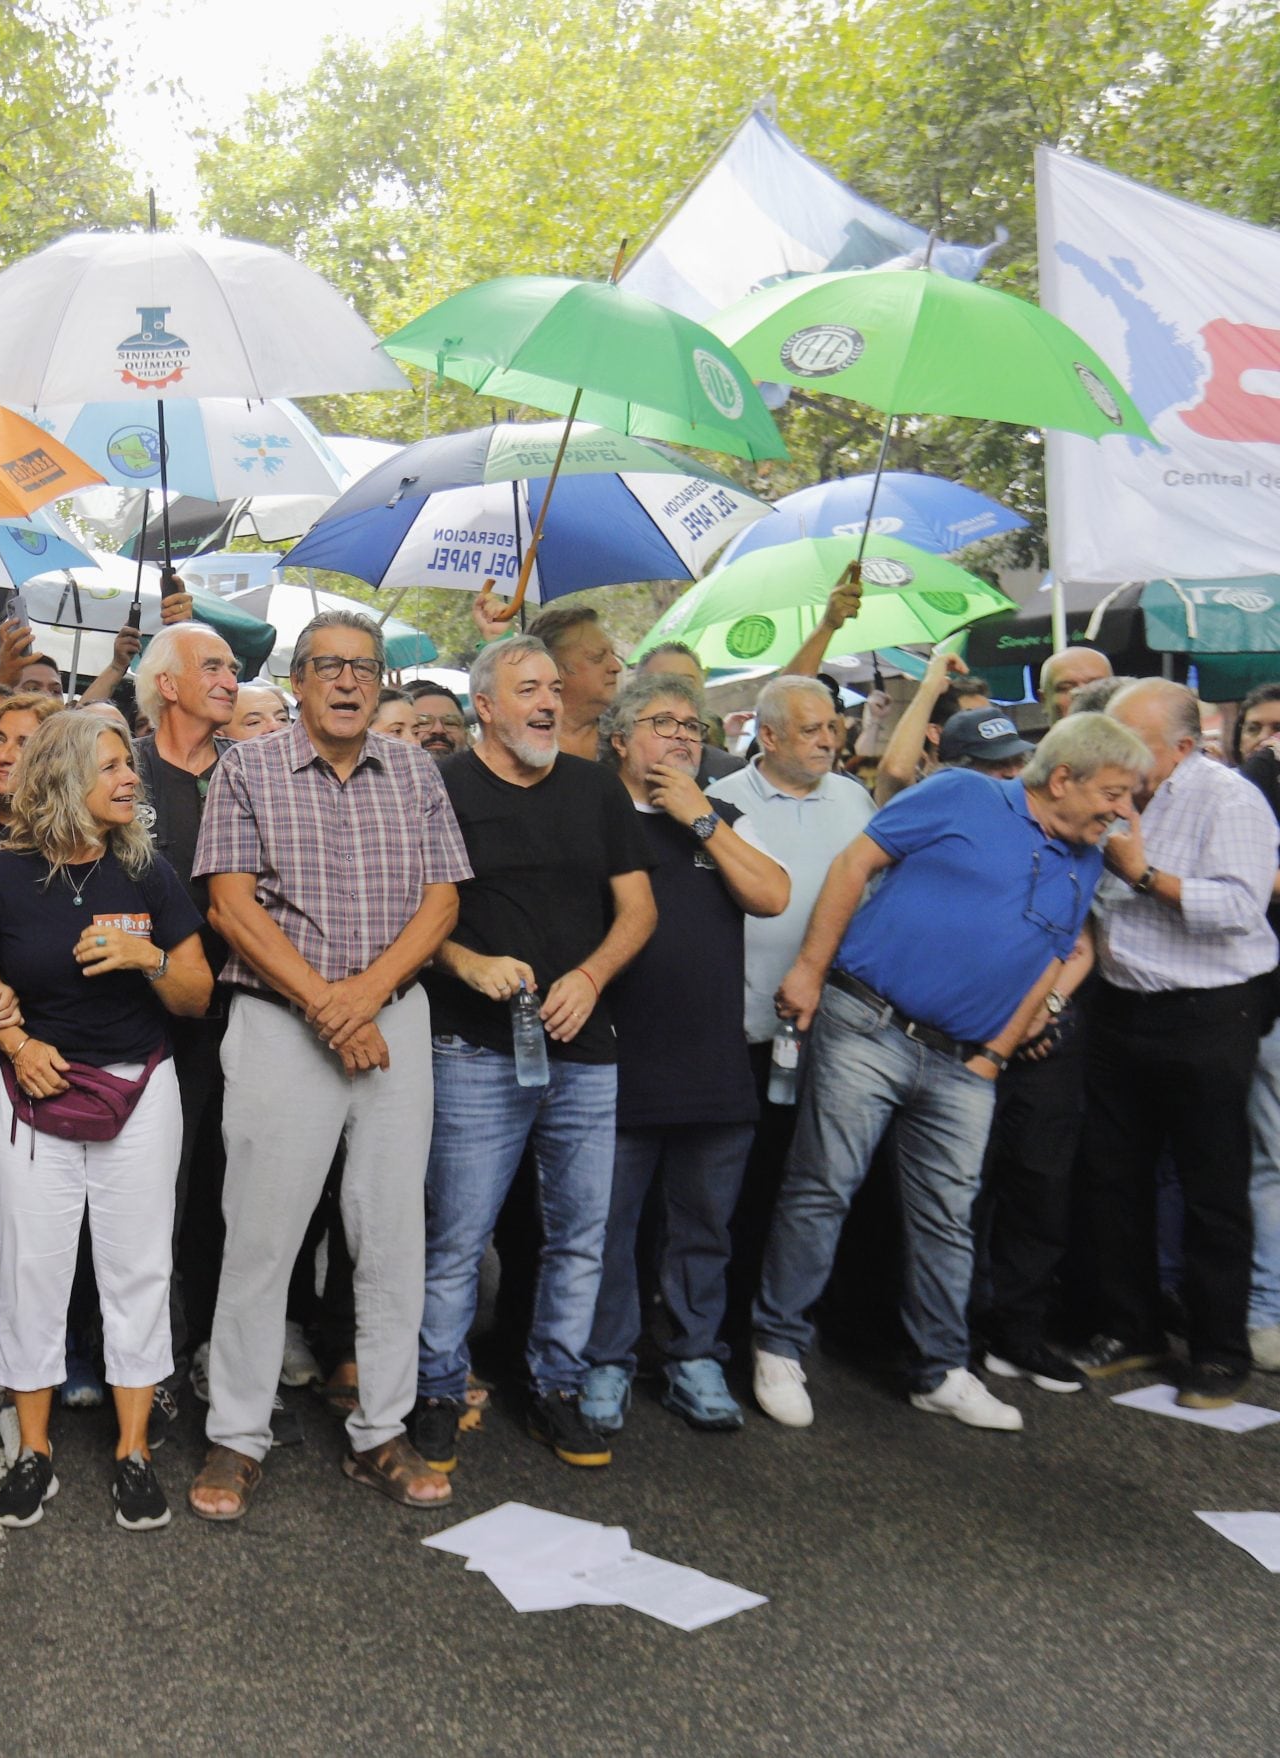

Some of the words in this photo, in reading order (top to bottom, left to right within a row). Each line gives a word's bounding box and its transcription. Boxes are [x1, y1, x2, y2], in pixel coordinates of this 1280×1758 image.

[118, 350, 190, 360] SINDICATO
[125, 359, 183, 370] QUÍMICO
[516, 451, 556, 466] DEL
[563, 449, 628, 463] PAPEL
[1163, 470, 1252, 488] Central
